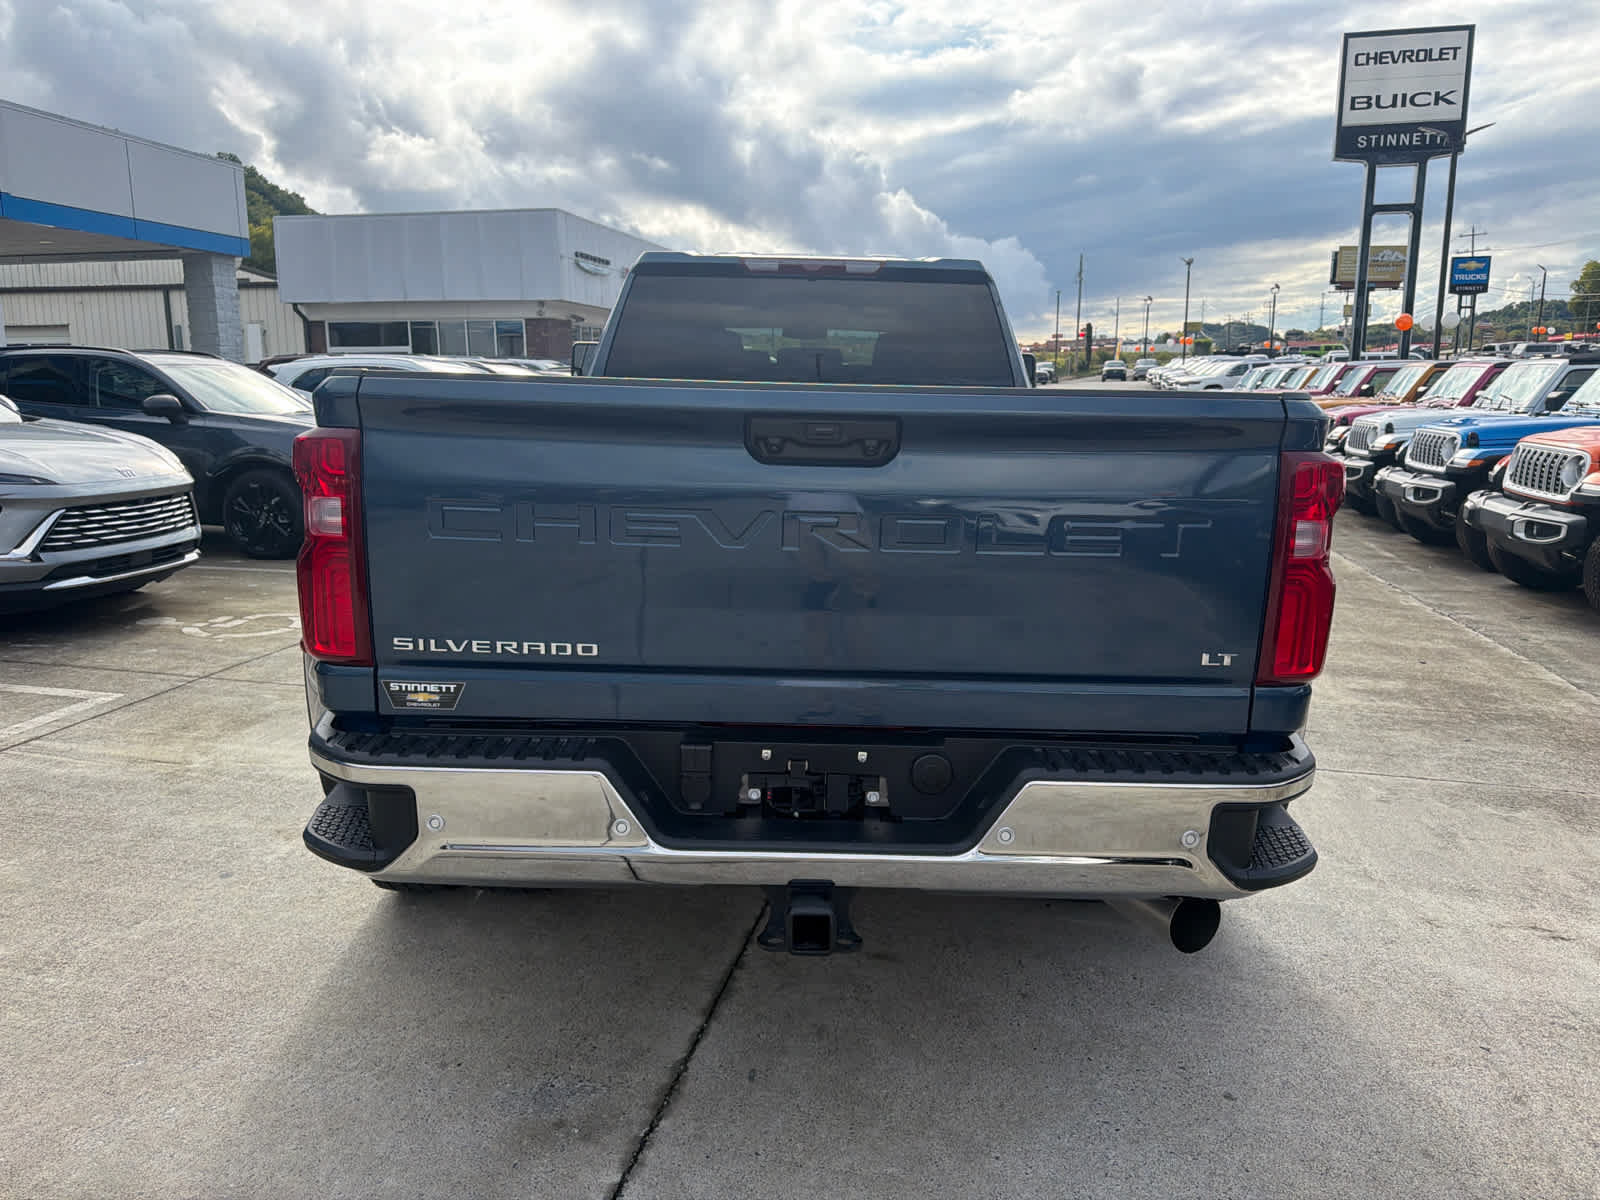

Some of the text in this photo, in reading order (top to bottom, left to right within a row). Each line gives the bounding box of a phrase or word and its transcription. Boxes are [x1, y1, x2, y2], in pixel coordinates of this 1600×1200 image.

[1354, 46, 1462, 67] CHEVROLET
[1349, 89, 1457, 111] BUICK
[1357, 131, 1444, 149] STINNETT
[1453, 273, 1487, 281] TRUCKS
[426, 496, 1213, 558] CHEVROLET
[392, 637, 599, 656] SILVERADO
[1201, 653, 1239, 666] LT
[390, 682, 457, 693] STINNETT
